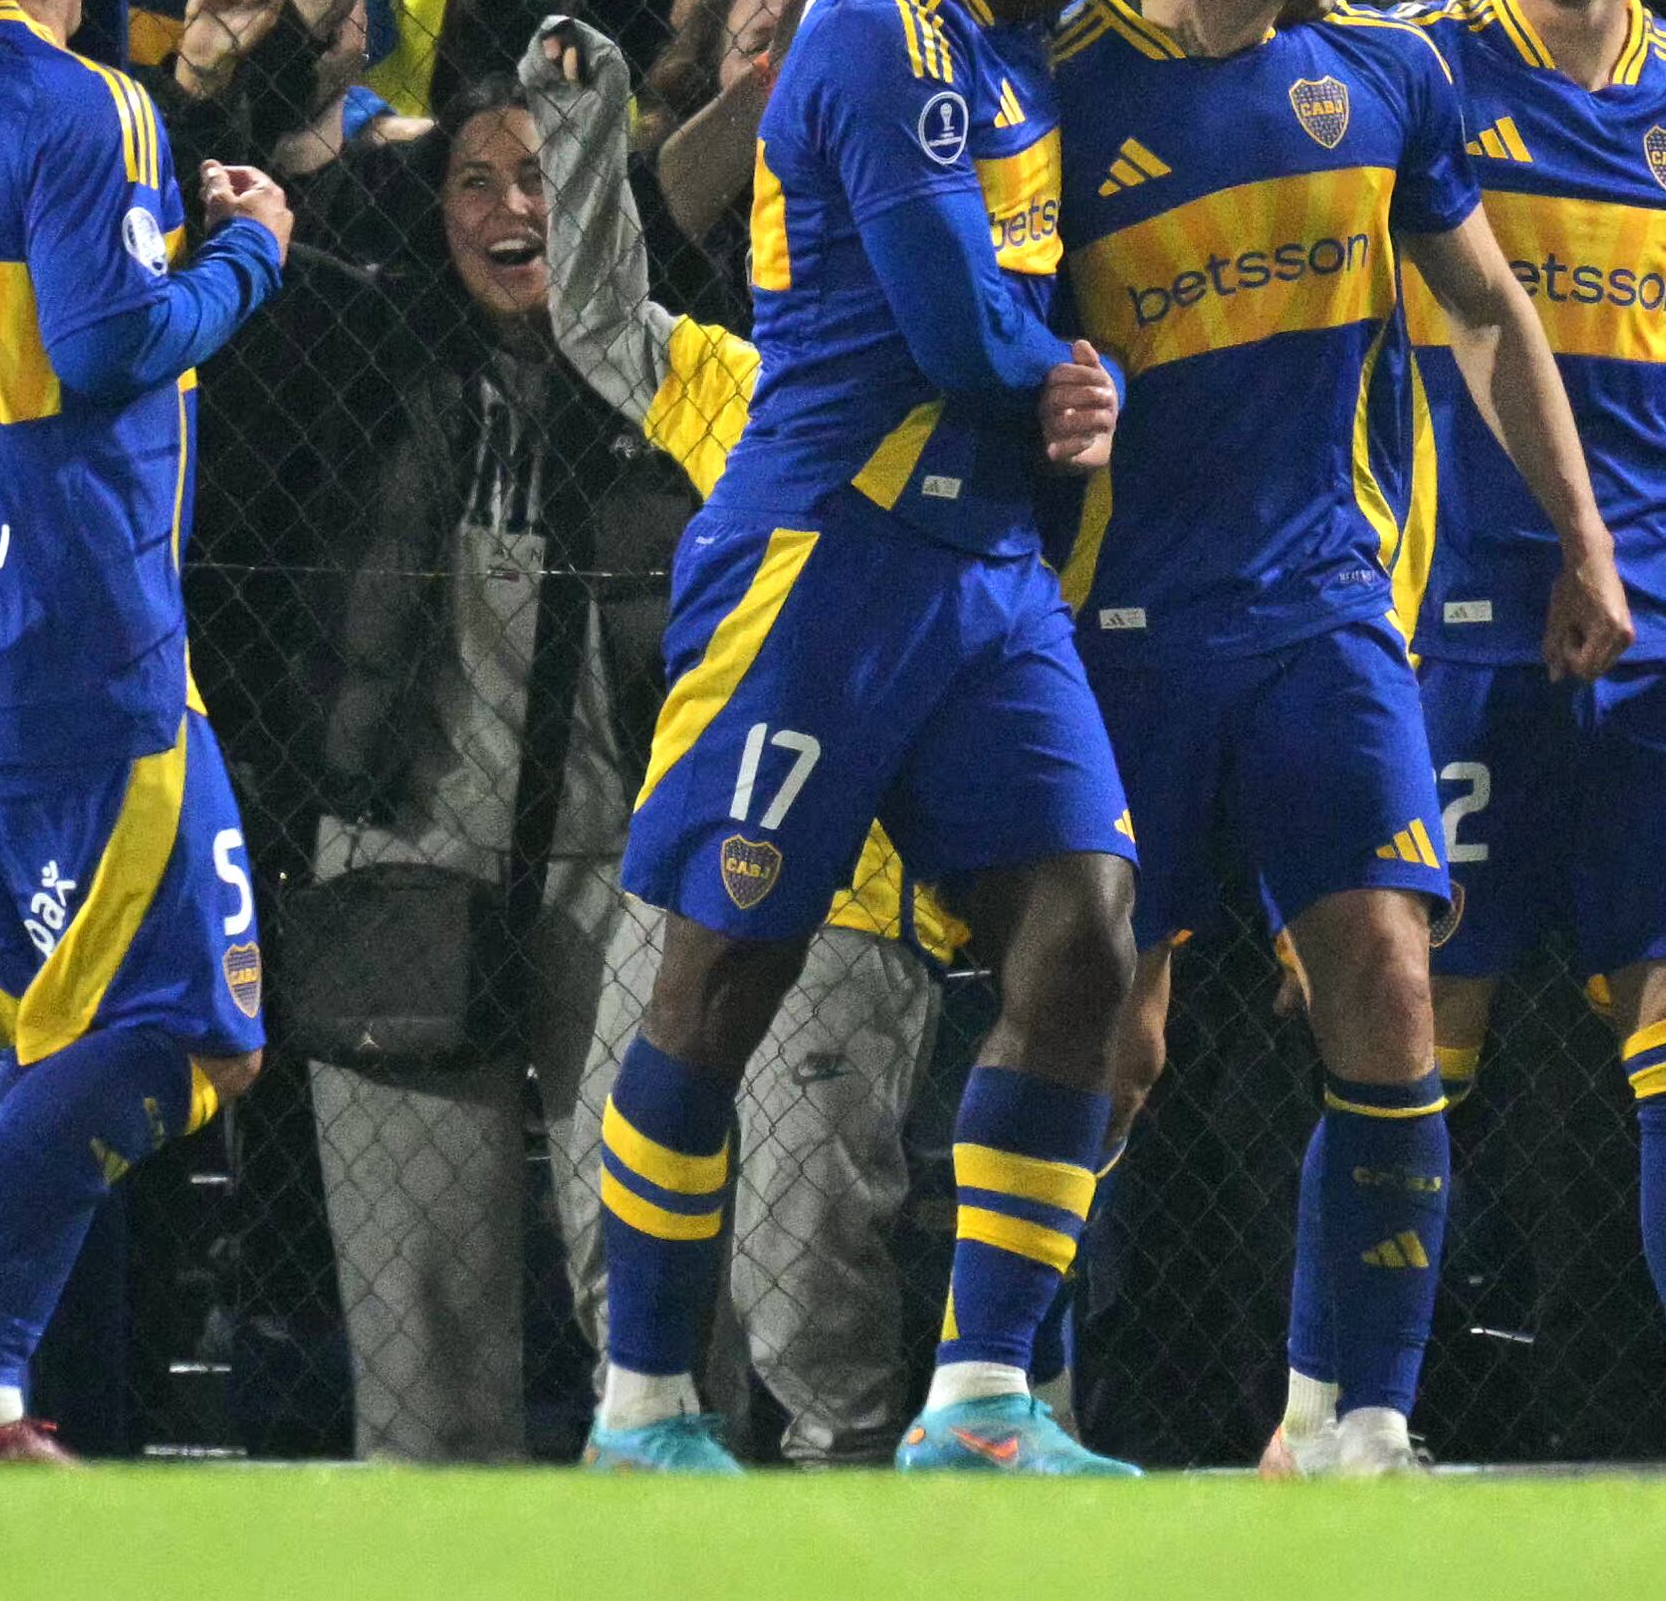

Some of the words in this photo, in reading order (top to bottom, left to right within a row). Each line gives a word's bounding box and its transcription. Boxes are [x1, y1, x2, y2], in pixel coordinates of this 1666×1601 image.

[1126, 232, 1370, 327] betsson
[729, 722, 821, 830] 17
[1432, 762, 1491, 863] 2
[213, 828, 253, 936] 5
